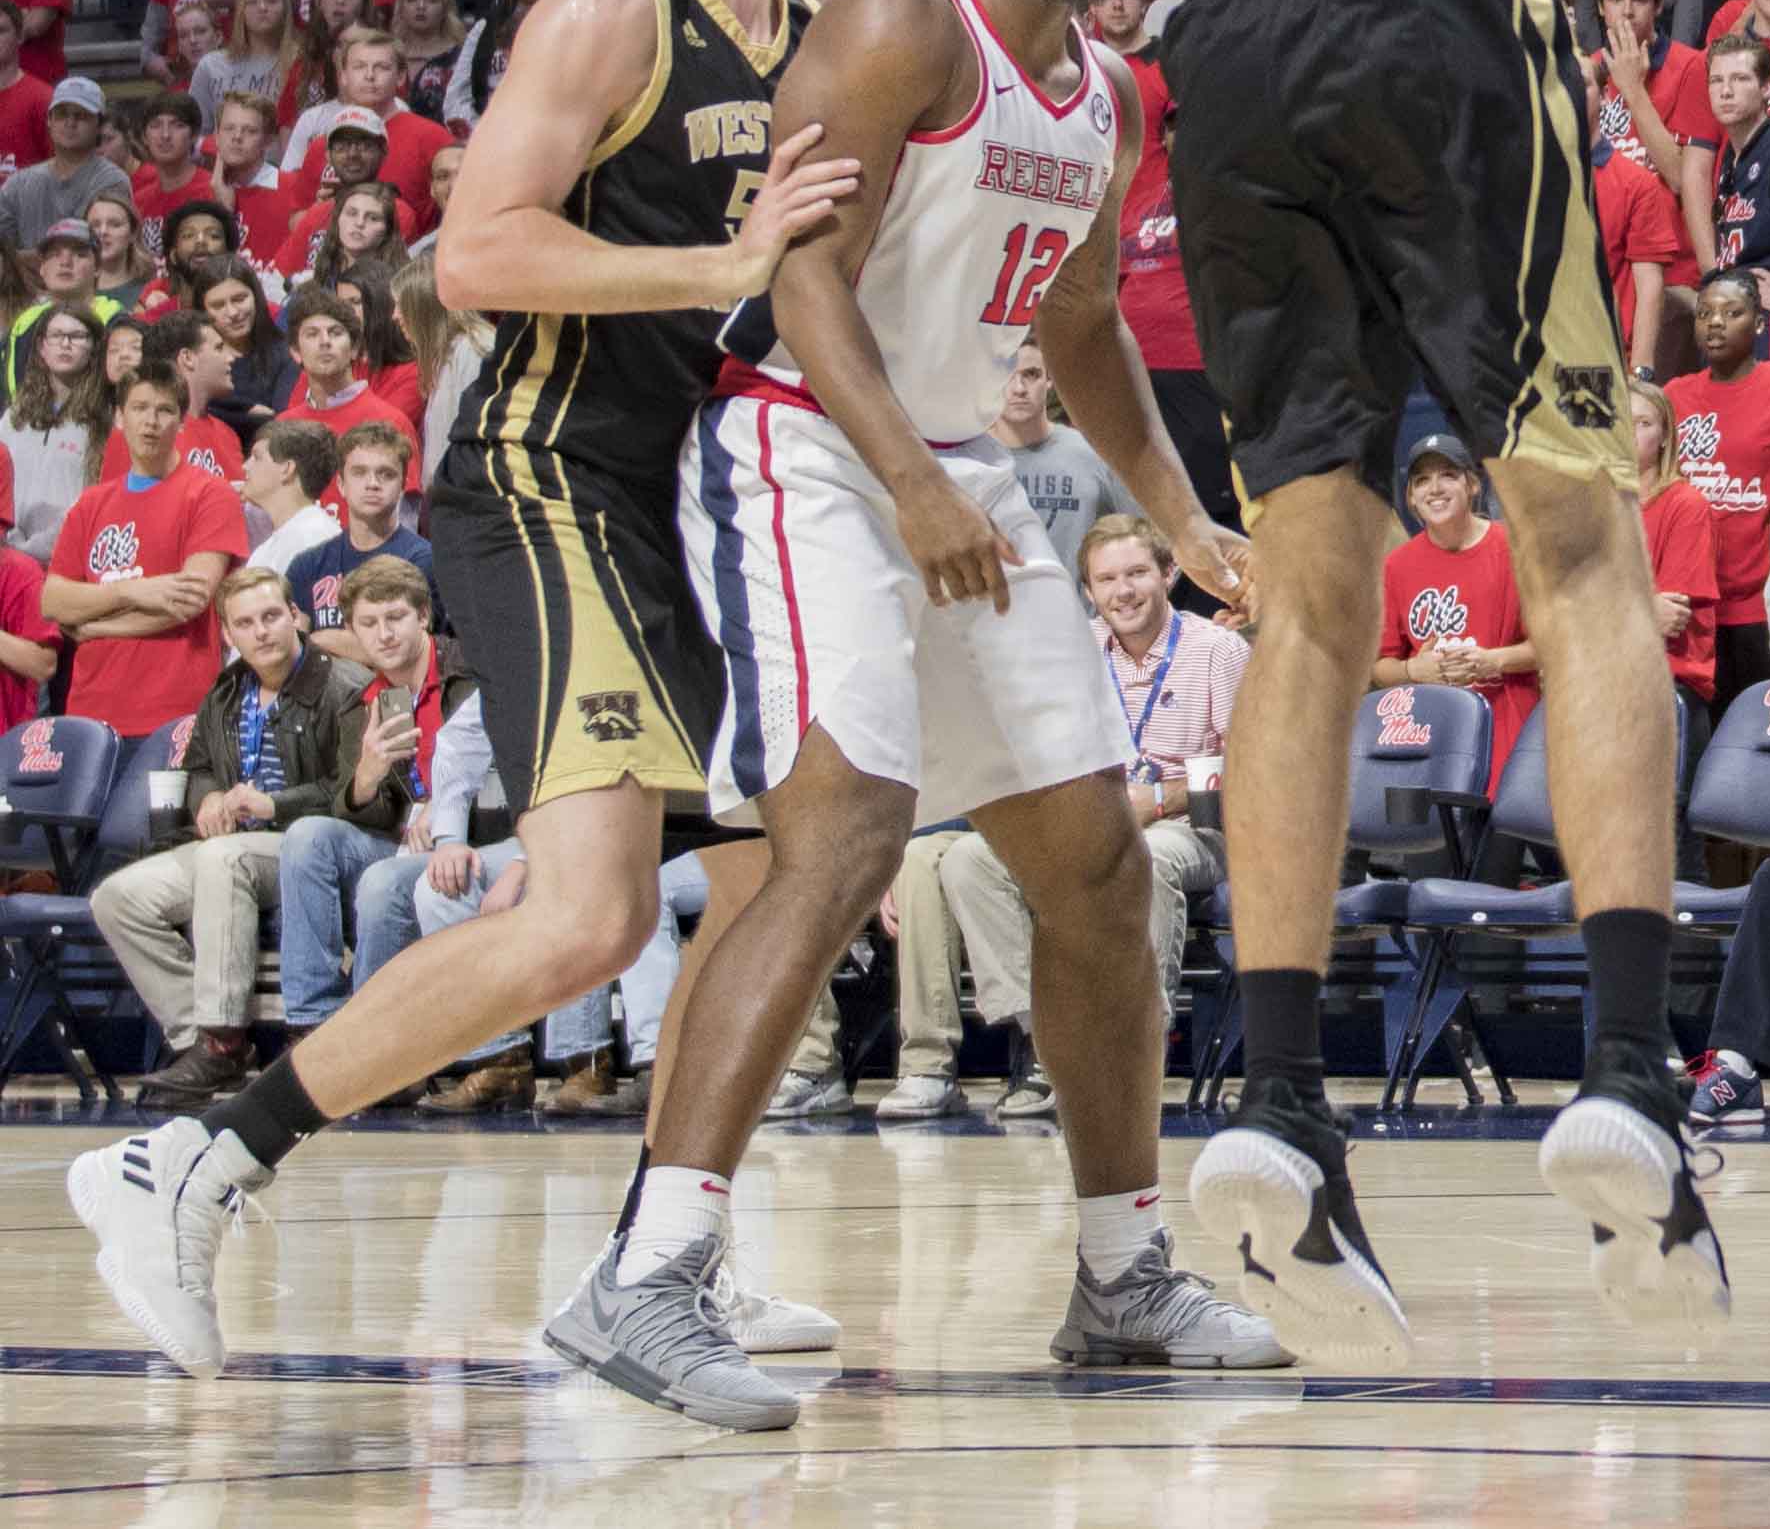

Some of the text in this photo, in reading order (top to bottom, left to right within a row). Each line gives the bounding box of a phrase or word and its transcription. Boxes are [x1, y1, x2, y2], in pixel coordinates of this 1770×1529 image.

[979, 221, 1070, 326] 12
[90, 521, 140, 574] Ole
[1409, 584, 1468, 640] Ole
[1377, 686, 1415, 717] Ole
[1378, 714, 1432, 746] Miss
